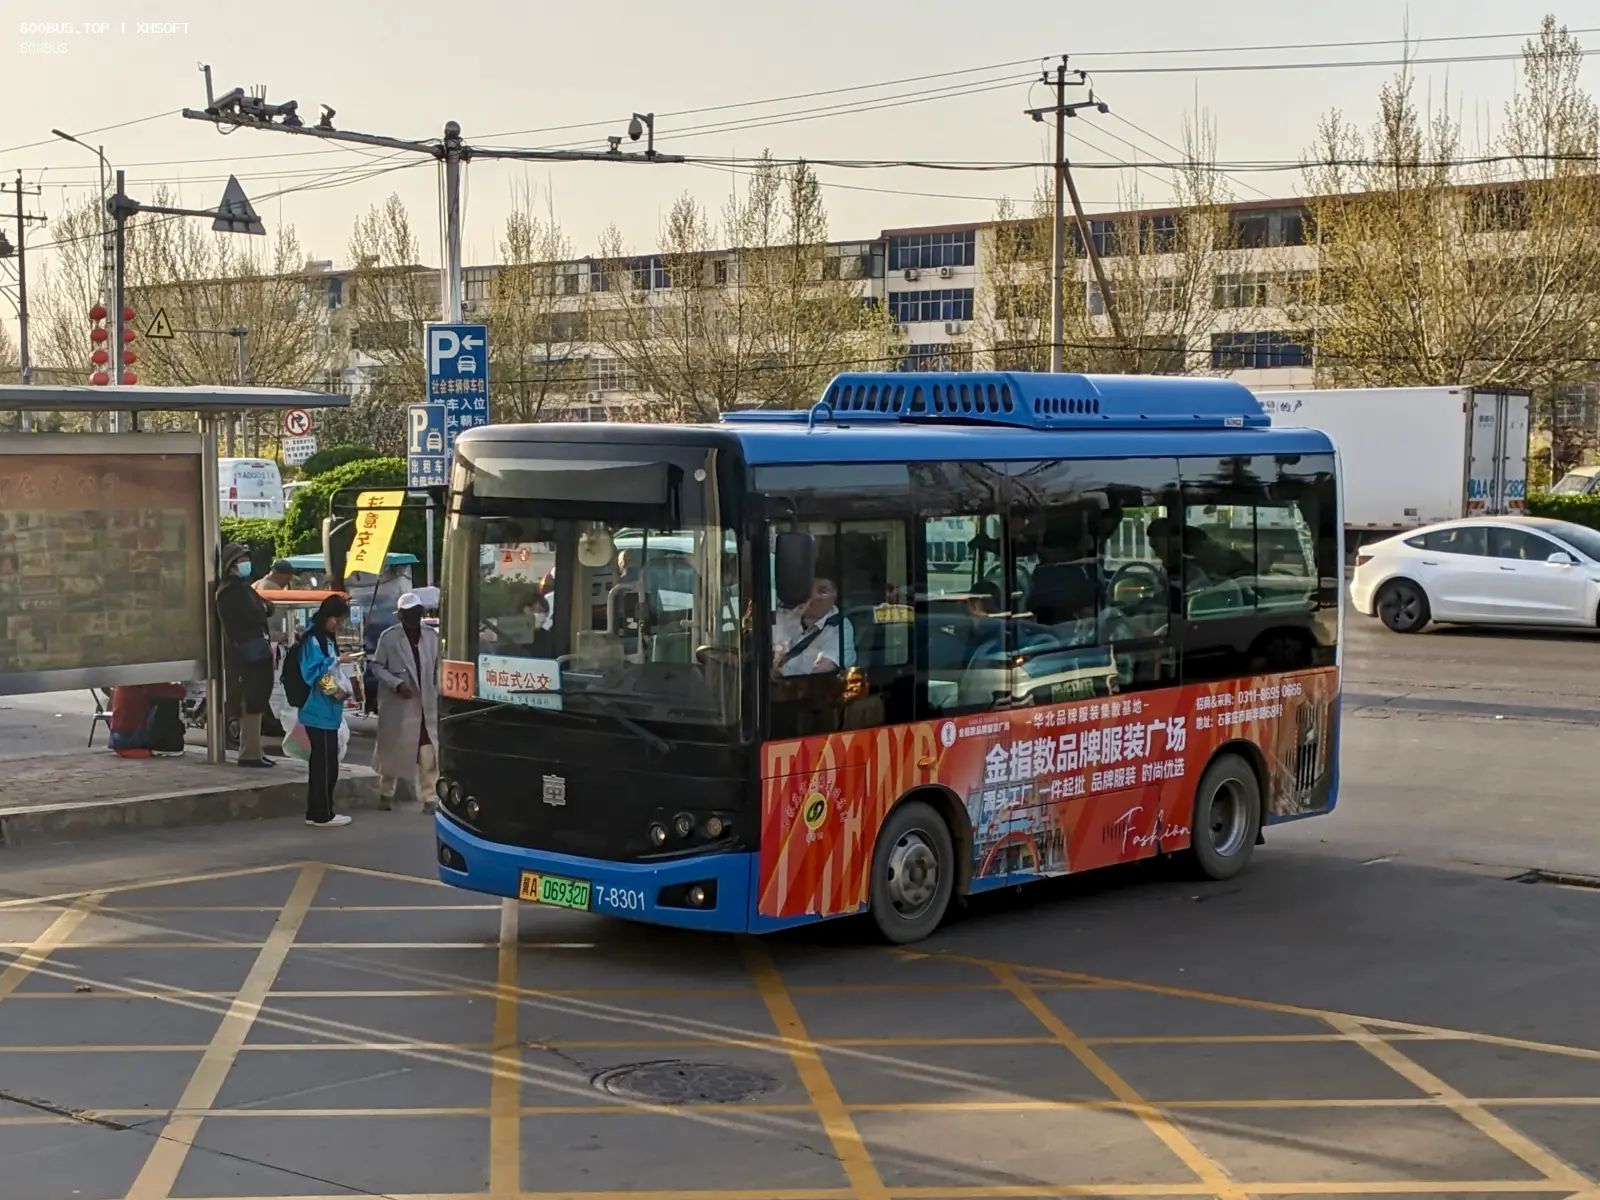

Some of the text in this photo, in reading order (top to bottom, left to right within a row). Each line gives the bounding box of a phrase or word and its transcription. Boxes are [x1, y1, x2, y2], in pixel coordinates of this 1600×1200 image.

[431, 330, 460, 375] P
[410, 408, 428, 453] P
[411, 459, 443, 474] 出租车
[446, 671, 470, 693] 513
[486, 669, 550, 692] 响应式公交
[985, 716, 1186, 785] 金指数品牌服装广场
[1039, 774, 1086, 800] 一件起批
[1091, 766, 1137, 792] 品牌服装
[1141, 757, 1185, 782] 时尚优选
[1114, 806, 1191, 854] Fashion
[596, 885, 645, 911] 7-8301
